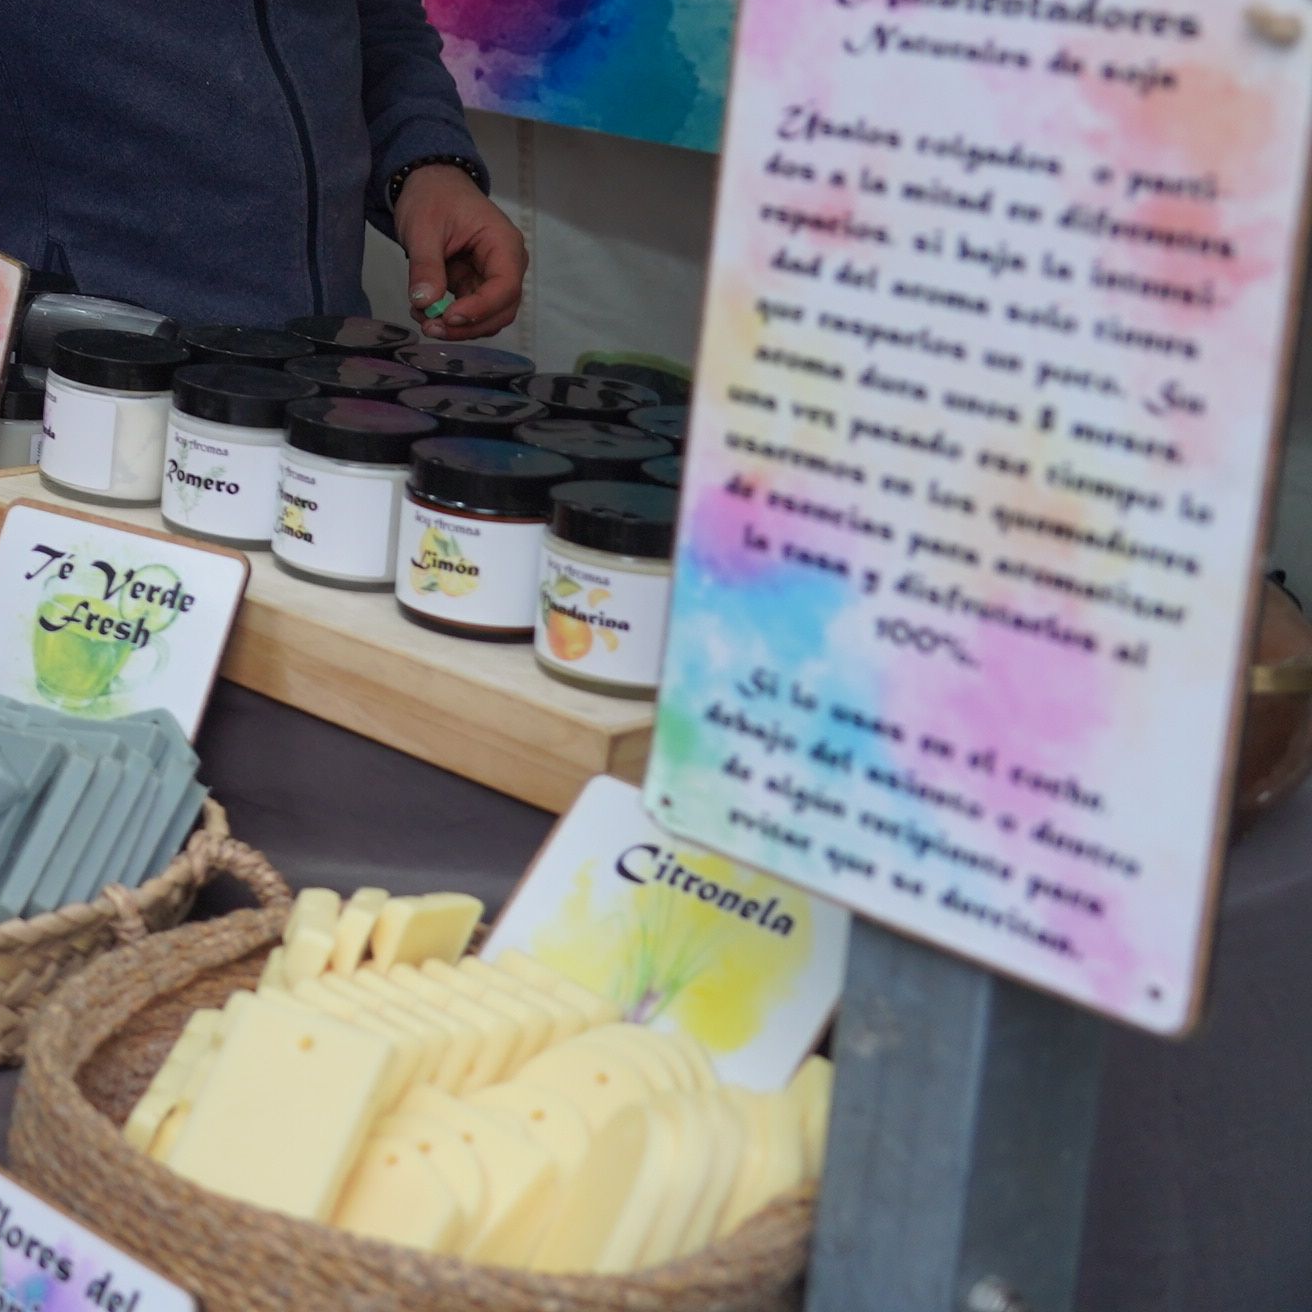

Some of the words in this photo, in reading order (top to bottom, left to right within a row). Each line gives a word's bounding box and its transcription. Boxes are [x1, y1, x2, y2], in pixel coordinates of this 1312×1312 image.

[843, 23, 1030, 70] Naturales
[1046, 46, 1083, 76] de
[859, 166, 888, 194] la
[770, 248, 823, 277] dad
[834, 260, 880, 290] del
[166, 458, 240, 495] Romero
[726, 473, 756, 501] de
[24, 543, 75, 580] Té
[89, 560, 196, 613] Verde
[410, 549, 480, 578] Limón
[615, 842, 795, 937] Citronela
